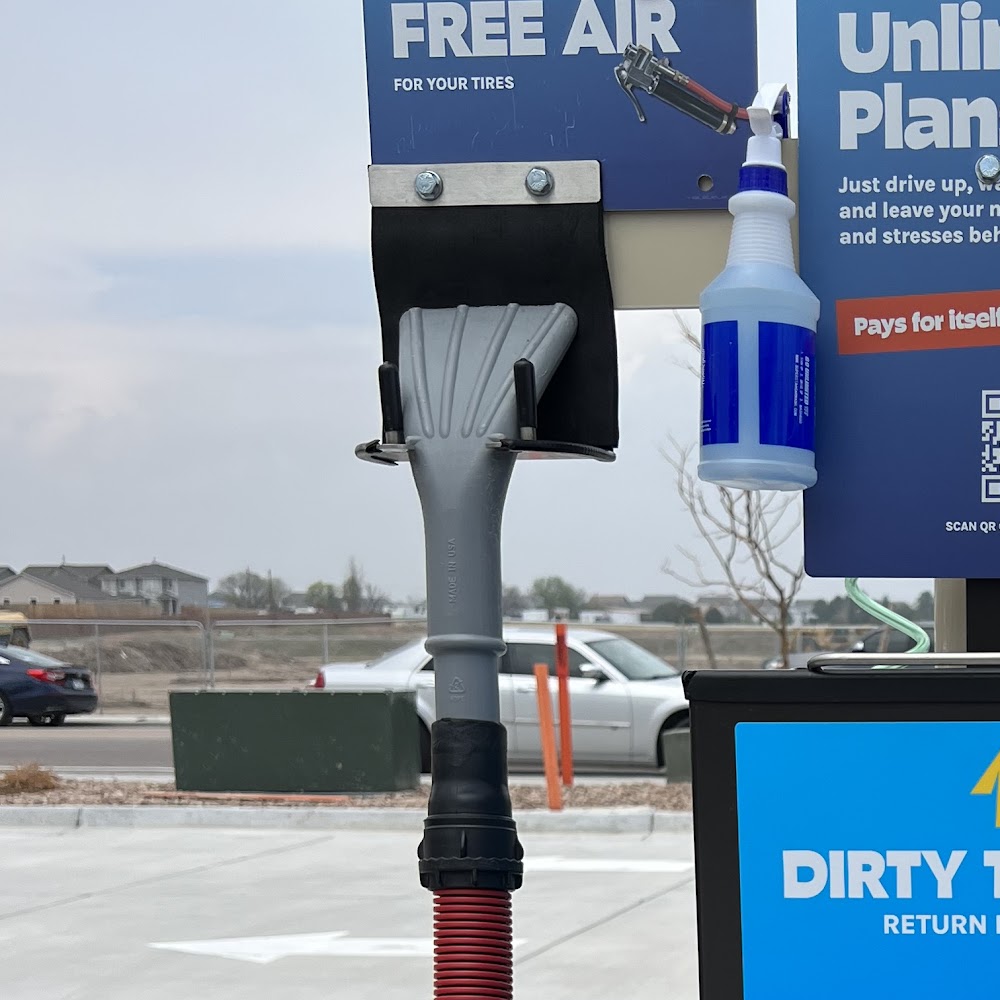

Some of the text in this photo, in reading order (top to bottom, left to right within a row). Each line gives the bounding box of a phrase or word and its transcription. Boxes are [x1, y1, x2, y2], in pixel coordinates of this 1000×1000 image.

[391, 0, 681, 58] FREE AIR
[394, 76, 515, 91] FOR YOUR TIRES
[838, 177, 880, 193] Just
[885, 174, 936, 192] drive
[941, 179, 973, 197] up,
[839, 202, 877, 219] and
[883, 201, 934, 218] leave
[938, 203, 984, 223] your
[839, 227, 877, 244] and
[882, 228, 964, 244] stresses
[854, 316, 908, 339] Pays
[911, 311, 944, 332] for
[945, 521, 977, 532] SCAN
[979, 521, 996, 534] QR
[782, 849, 967, 899] DIRTY
[883, 914, 987, 935] RETURN
